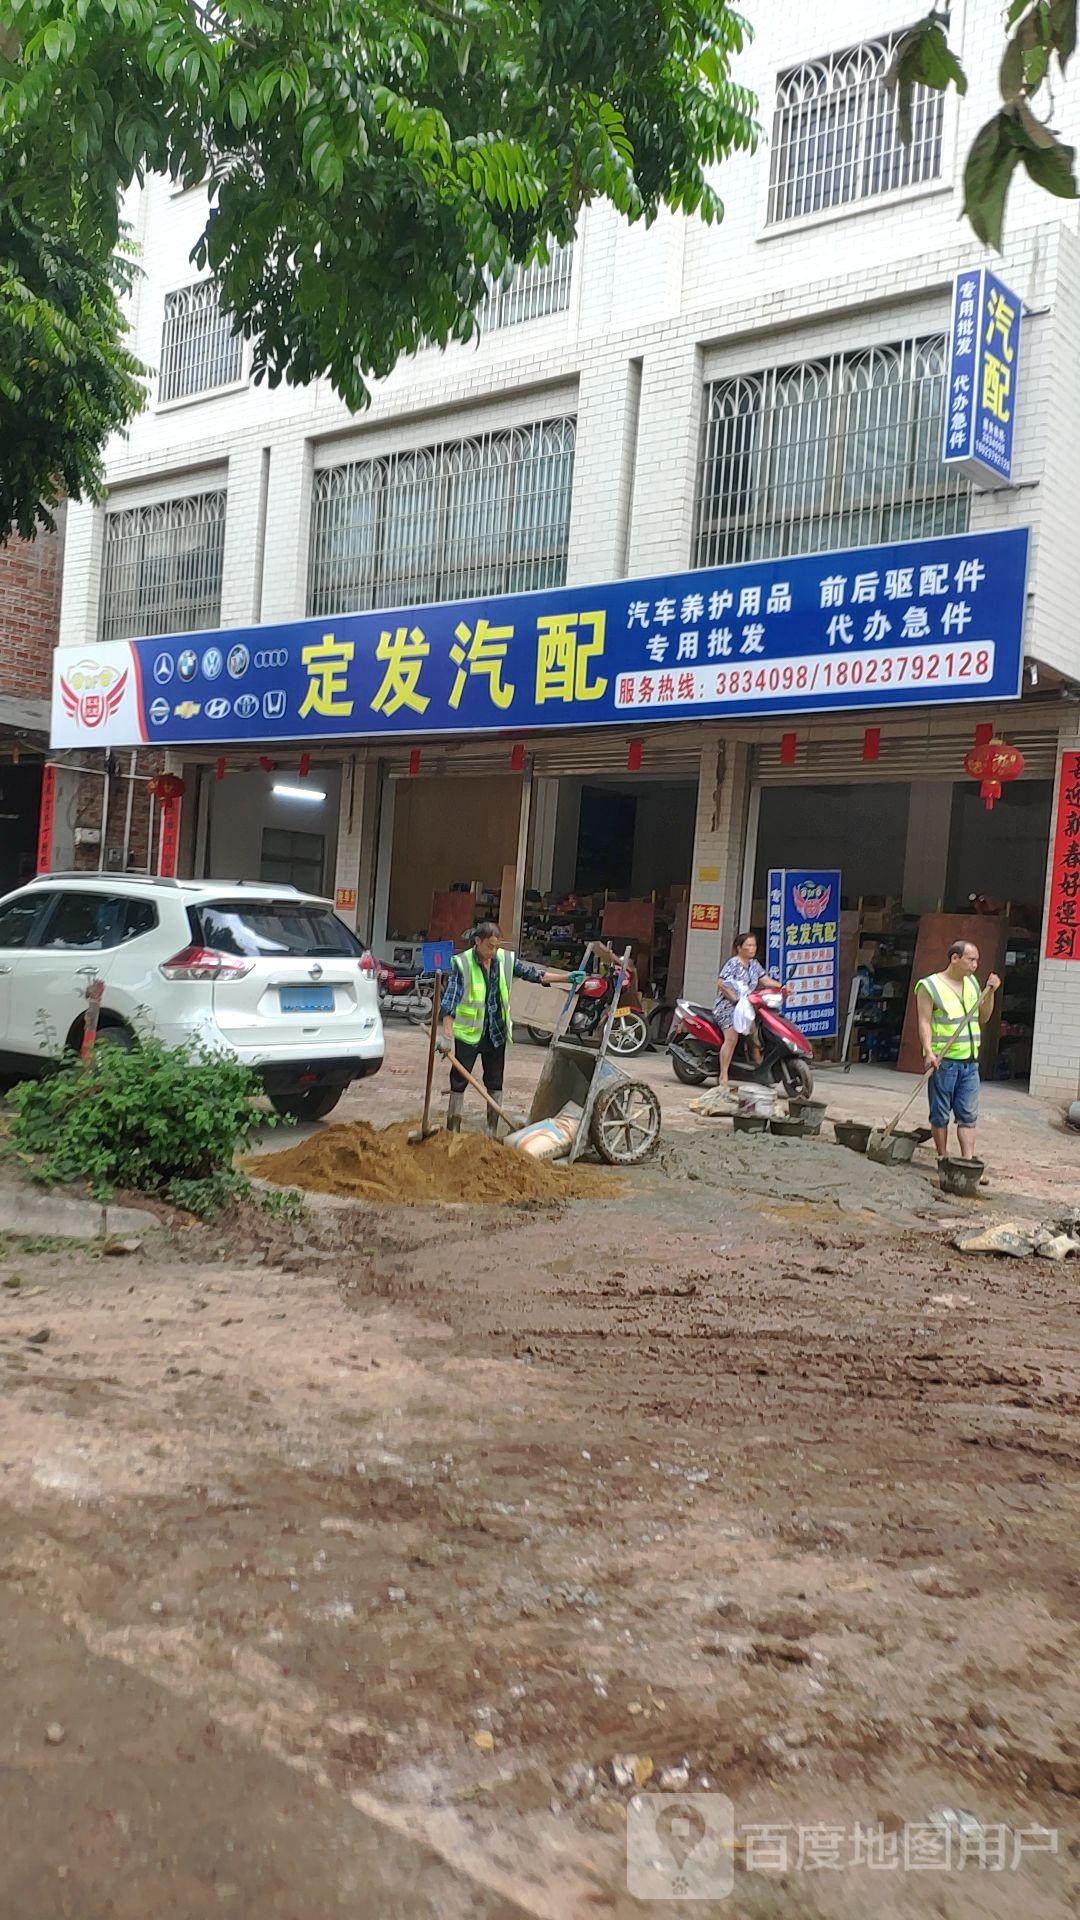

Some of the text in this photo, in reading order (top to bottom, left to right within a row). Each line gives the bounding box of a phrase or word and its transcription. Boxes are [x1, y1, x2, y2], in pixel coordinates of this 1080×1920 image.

[949, 280, 977, 450] 专用批发 代办急件
[982, 287, 1015, 424] 汽配
[627, 559, 986, 630] 汽车养护用品 前后驱配件
[298, 610, 609, 719] 定发汽配
[645, 602, 973, 664] 专用批发 代办急件
[692, 904, 719, 921] 拖车
[786, 922, 837, 947] 定发汽配
